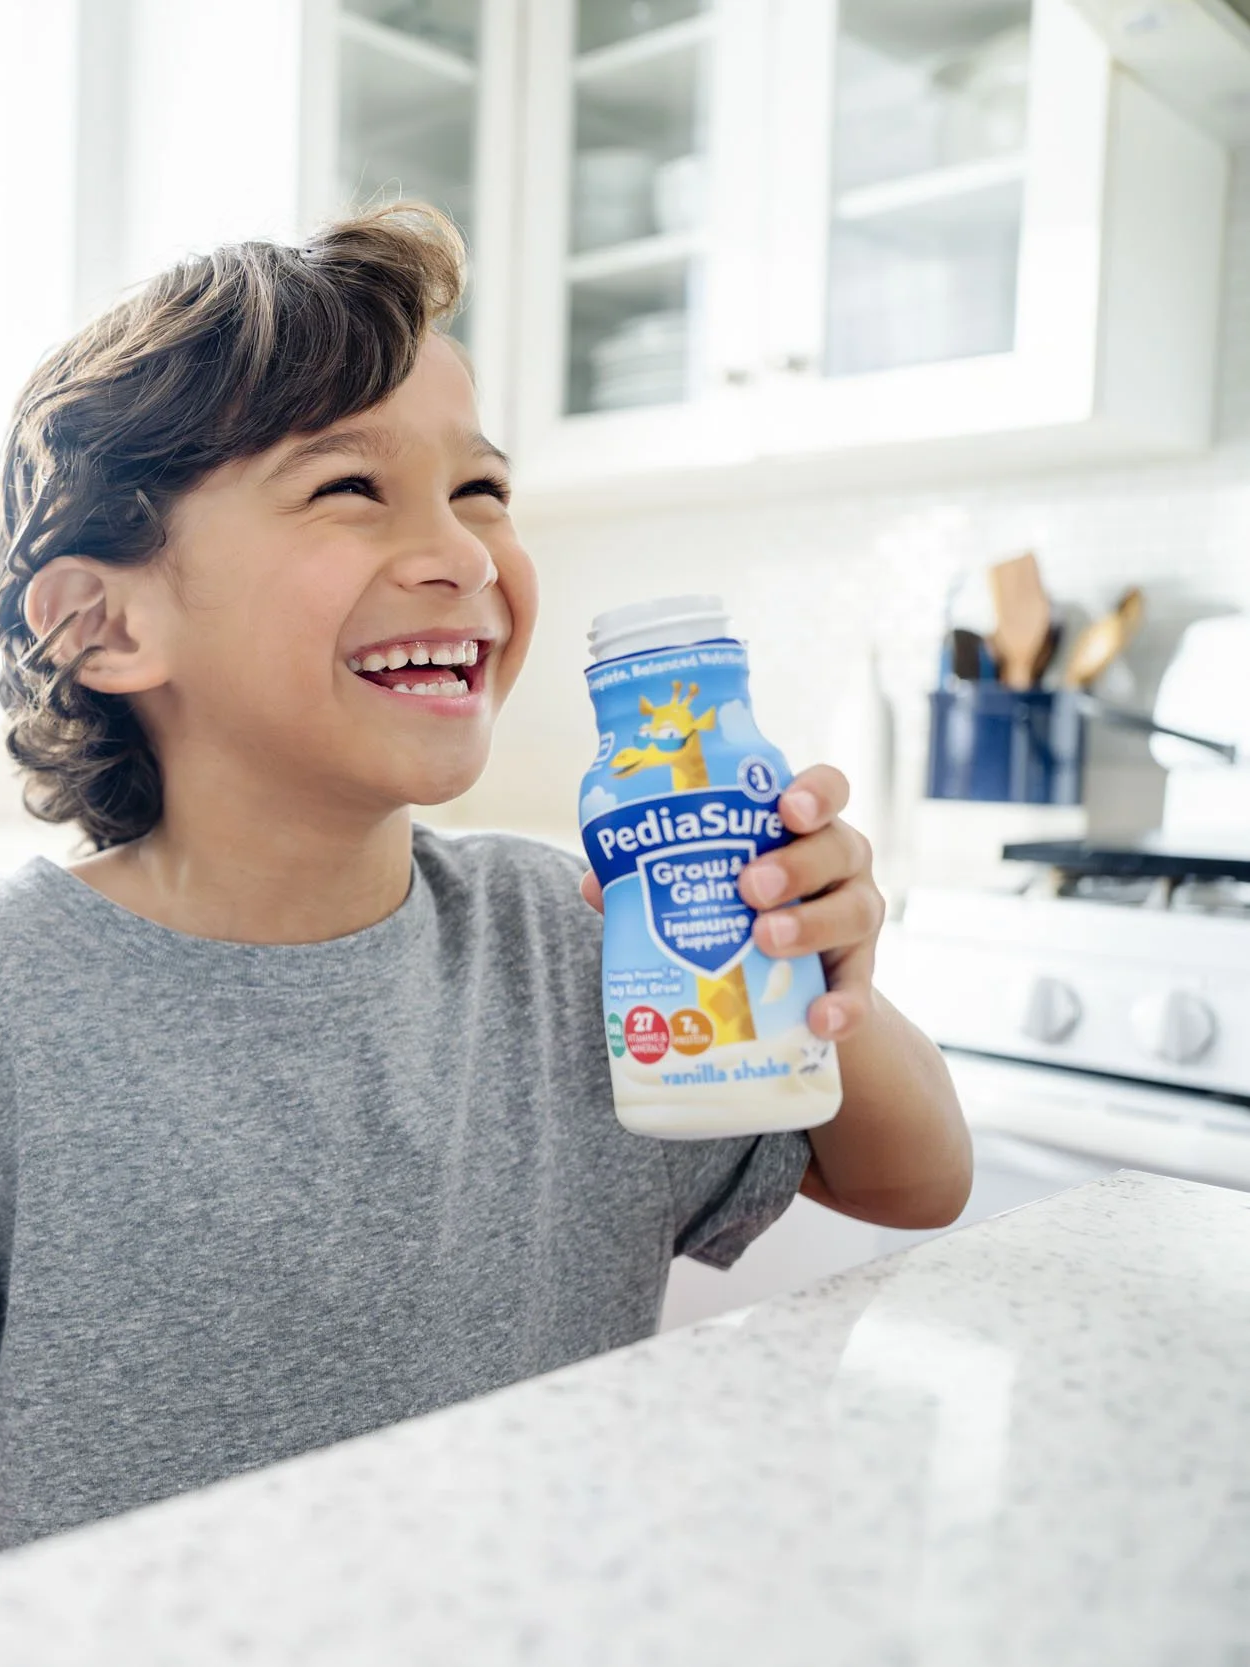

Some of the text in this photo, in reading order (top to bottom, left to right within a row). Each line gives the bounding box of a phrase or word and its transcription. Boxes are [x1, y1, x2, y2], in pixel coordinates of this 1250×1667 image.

[597, 802, 784, 861] PediaSure
[662, 914, 749, 938] Immune
[633, 1011, 655, 1033] 27
[661, 1056, 791, 1085] vanilla shake
